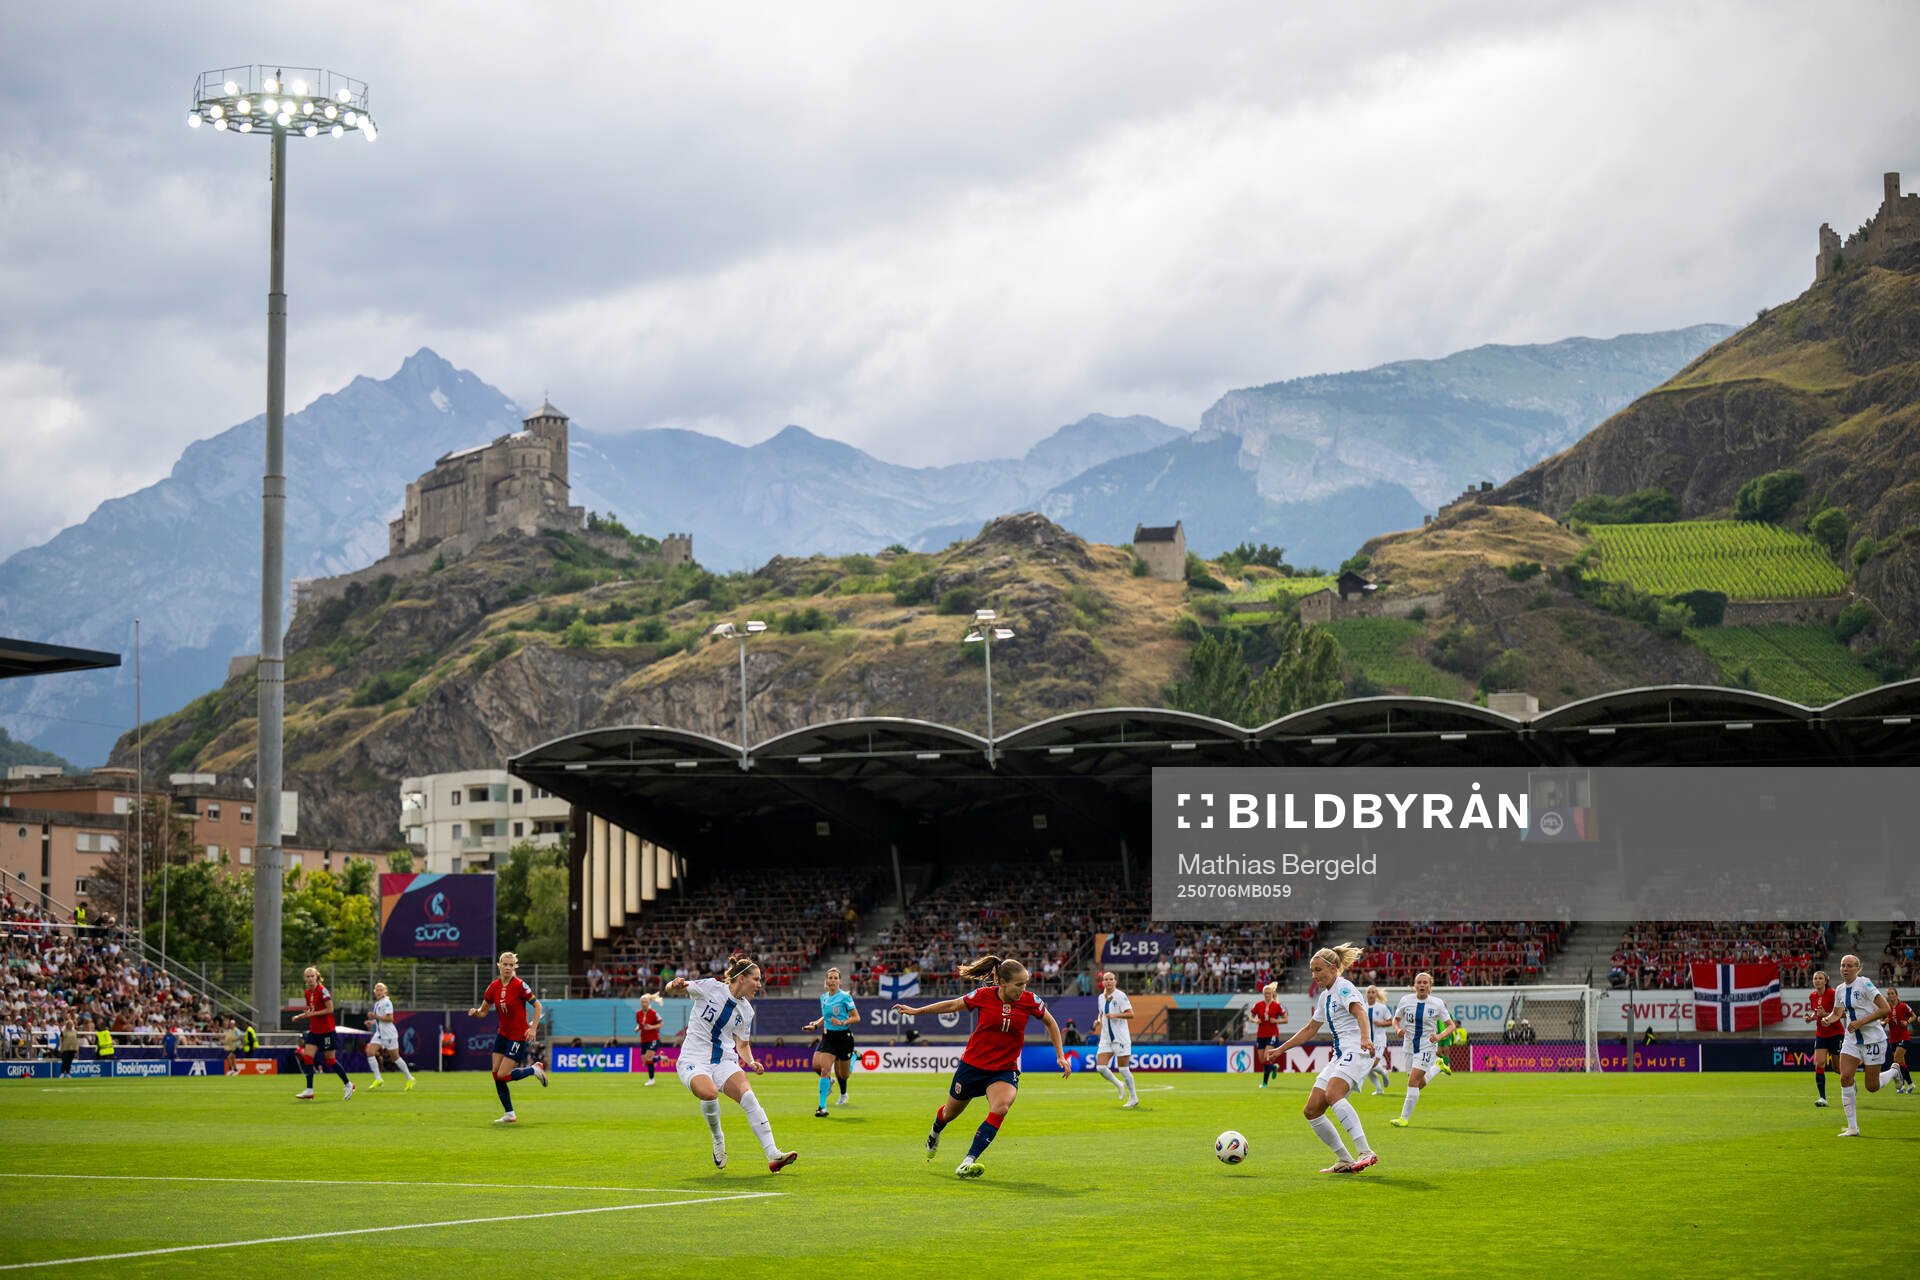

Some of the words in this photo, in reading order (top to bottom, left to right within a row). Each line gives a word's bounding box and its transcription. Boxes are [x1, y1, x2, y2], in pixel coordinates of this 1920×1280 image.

[701, 1005, 717, 1023] 15
[871, 1008, 915, 1025] SION
[1454, 1005, 1503, 1020] EURO
[1621, 1003, 1693, 1019] SWITZE
[1782, 1003, 1813, 1018] 025
[1002, 1018, 1010, 1032] 11
[511, 1041, 520, 1053] 14
[1866, 1044, 1879, 1055] 20
[557, 1054, 624, 1068] RECYCLE
[776, 1058, 809, 1068] MUTE
[883, 1052, 960, 1072] Swissquo
[1508, 1056, 1536, 1067] time
[1540, 1056, 1554, 1067] to
[1601, 1057, 1629, 1067] OFF
[1647, 1057, 1686, 1067] MUTE
[7, 1065, 35, 1076] GRIFOLS
[116, 1062, 166, 1076] Booking.com
[189, 1061, 207, 1076] AXA
